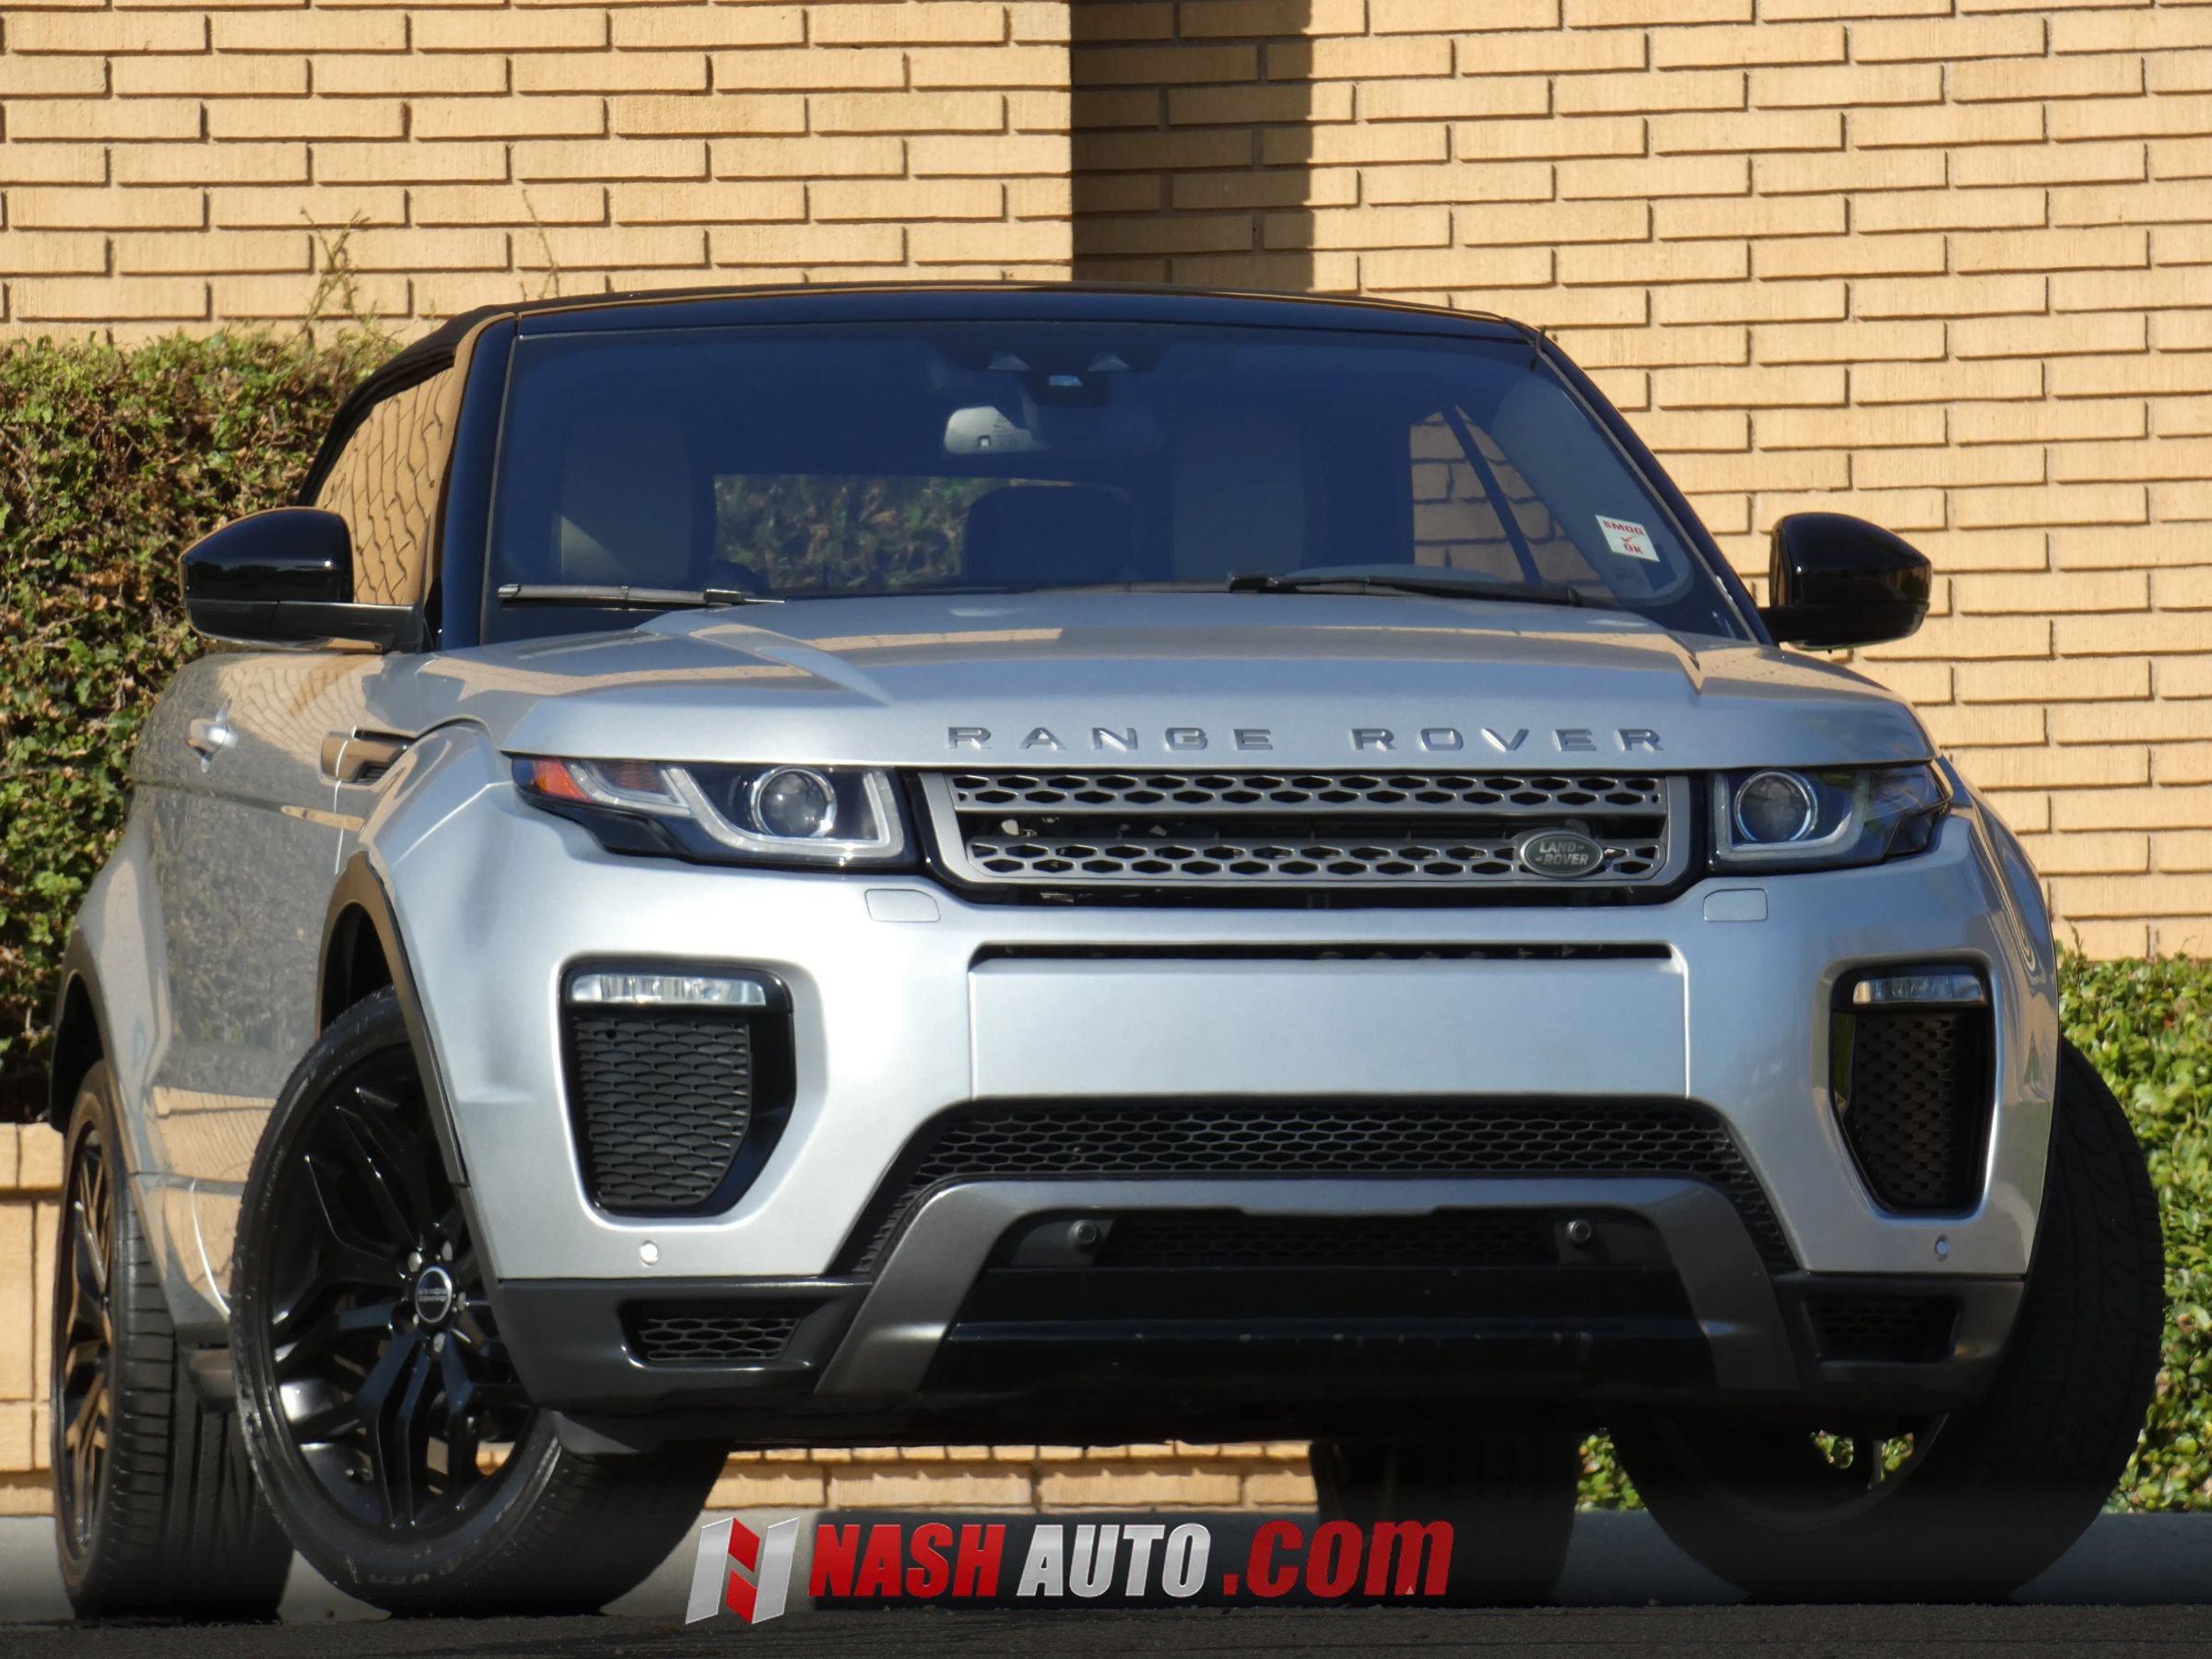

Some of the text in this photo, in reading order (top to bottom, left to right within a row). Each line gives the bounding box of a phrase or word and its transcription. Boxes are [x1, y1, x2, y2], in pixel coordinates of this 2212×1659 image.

[1603, 520, 1644, 535] SMOG
[1623, 543, 1643, 555] OK
[947, 725, 1665, 752] RANGE ROVER
[1539, 841, 1577, 853] LAND
[1544, 853, 1589, 865] ROVER
